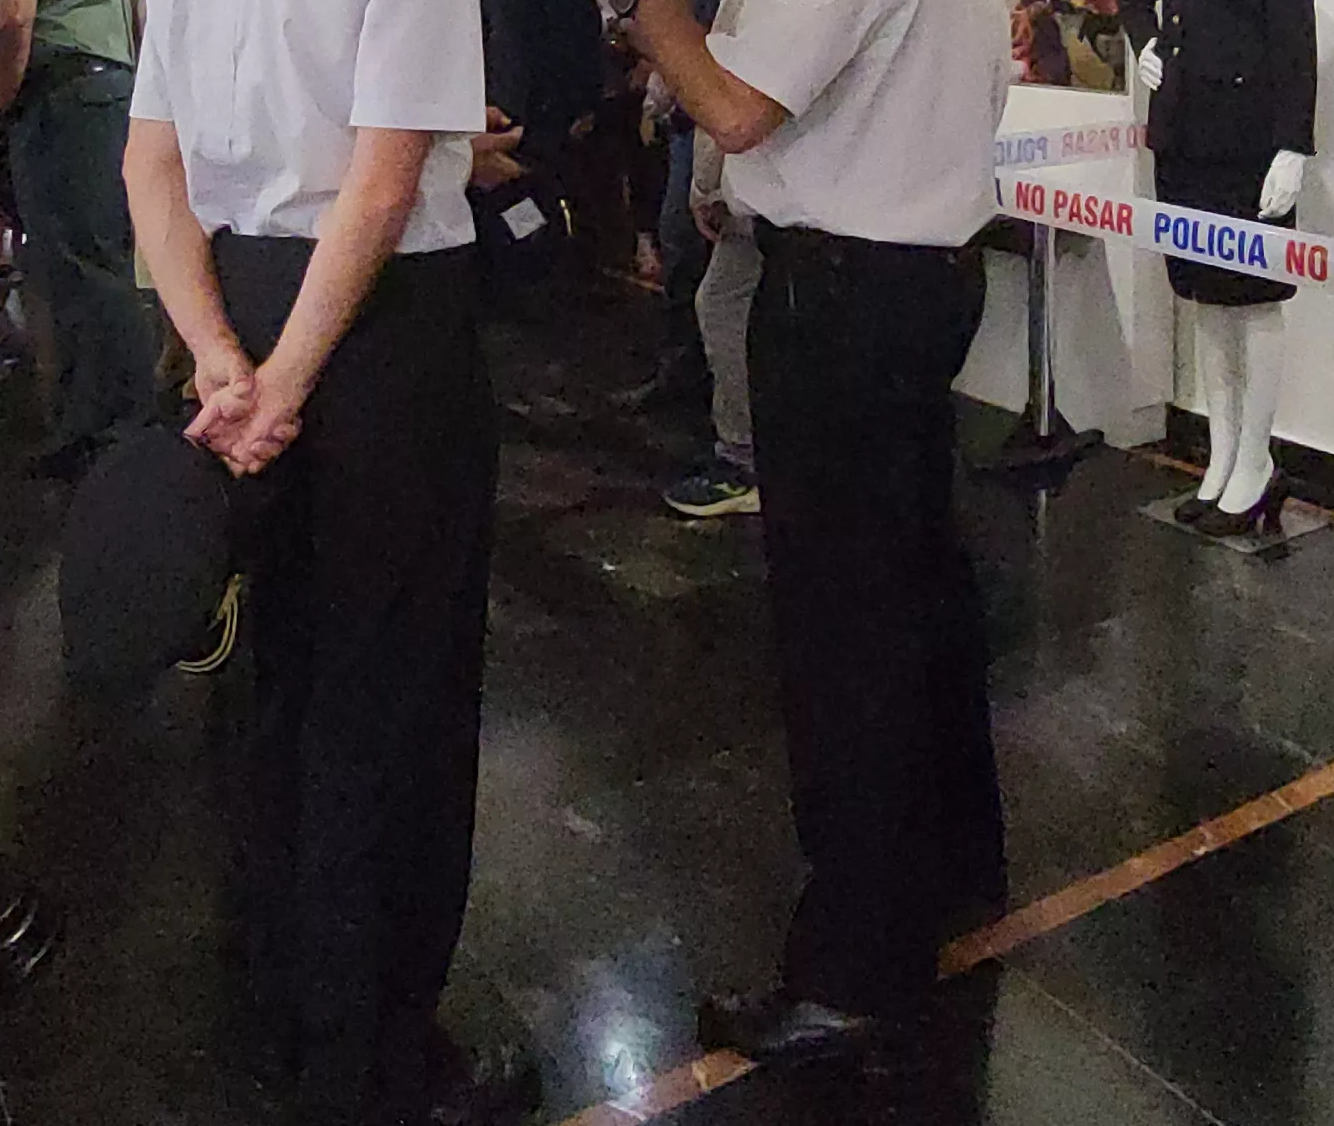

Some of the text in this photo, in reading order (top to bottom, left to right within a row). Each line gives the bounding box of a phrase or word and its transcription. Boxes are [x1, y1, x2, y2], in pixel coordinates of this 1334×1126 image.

[1016, 181, 1045, 216] NO
[1053, 189, 1133, 236] PASAR
[1154, 212, 1268, 269] POLICIA
[1285, 239, 1328, 282] NO
